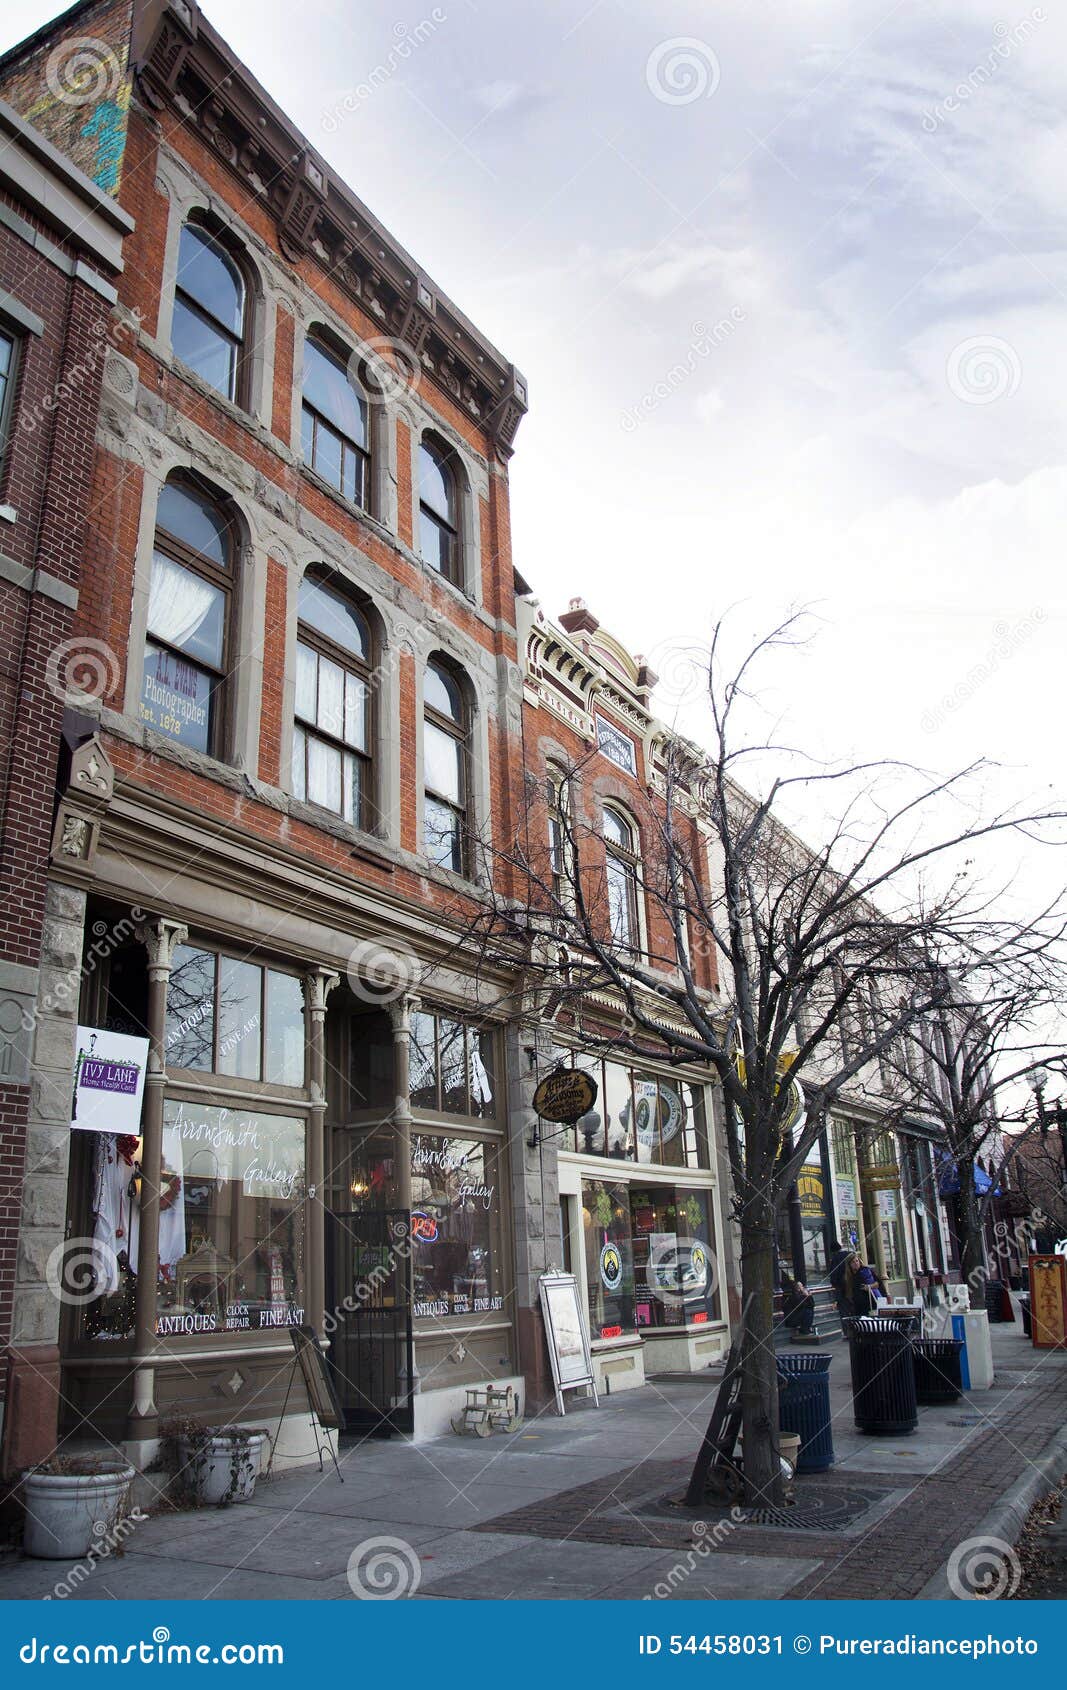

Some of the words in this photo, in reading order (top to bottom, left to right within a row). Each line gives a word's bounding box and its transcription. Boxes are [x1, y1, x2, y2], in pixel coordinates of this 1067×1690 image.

[144, 674, 206, 726] Photographer
[166, 1000, 214, 1047] ANTIQUES
[85, 1062, 104, 1079] IVY
[107, 1066, 136, 1084] LANE
[243, 1157, 298, 1200] Gallery
[458, 1176, 495, 1210] Gallery
[226, 1304, 249, 1316] CLOCK
[413, 1301, 449, 1317] ANTIQUES
[474, 1298, 489, 1312] FINE
[490, 1296, 503, 1310] ART
[156, 1313, 216, 1334] ANTIQUES
[226, 1317, 250, 1329] REPAIR
[260, 1310, 284, 1326] FINE
